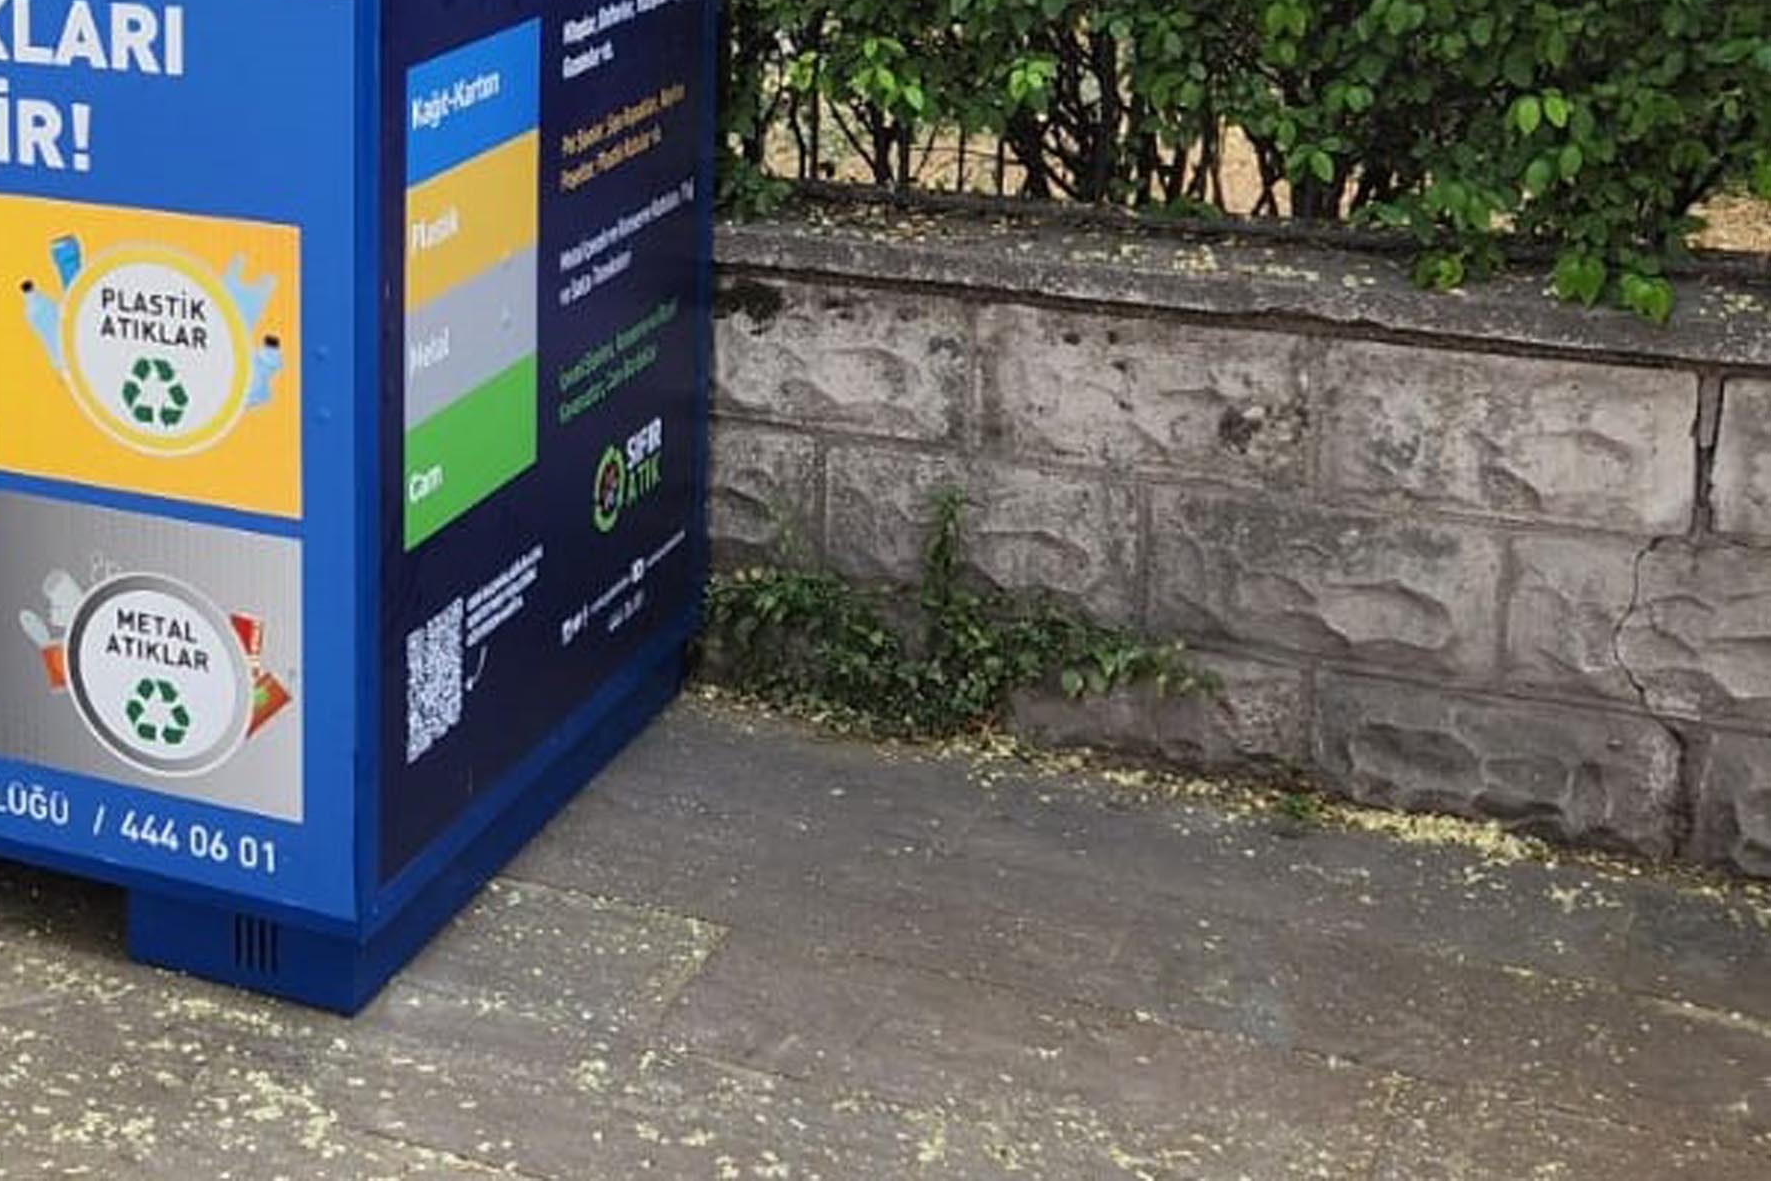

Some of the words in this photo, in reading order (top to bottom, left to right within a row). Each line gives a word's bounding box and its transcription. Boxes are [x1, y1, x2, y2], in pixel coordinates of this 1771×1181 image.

[101, 287, 207, 323] PLASTİK
[99, 315, 209, 351] ATIKLAR
[409, 464, 444, 503] Cam
[628, 459, 662, 506] ATIK
[116, 607, 199, 645] METAL
[105, 633, 211, 673] ATIKLAR
[120, 810, 179, 851] 444
[189, 825, 229, 863] 06
[239, 836, 277, 874] 01
